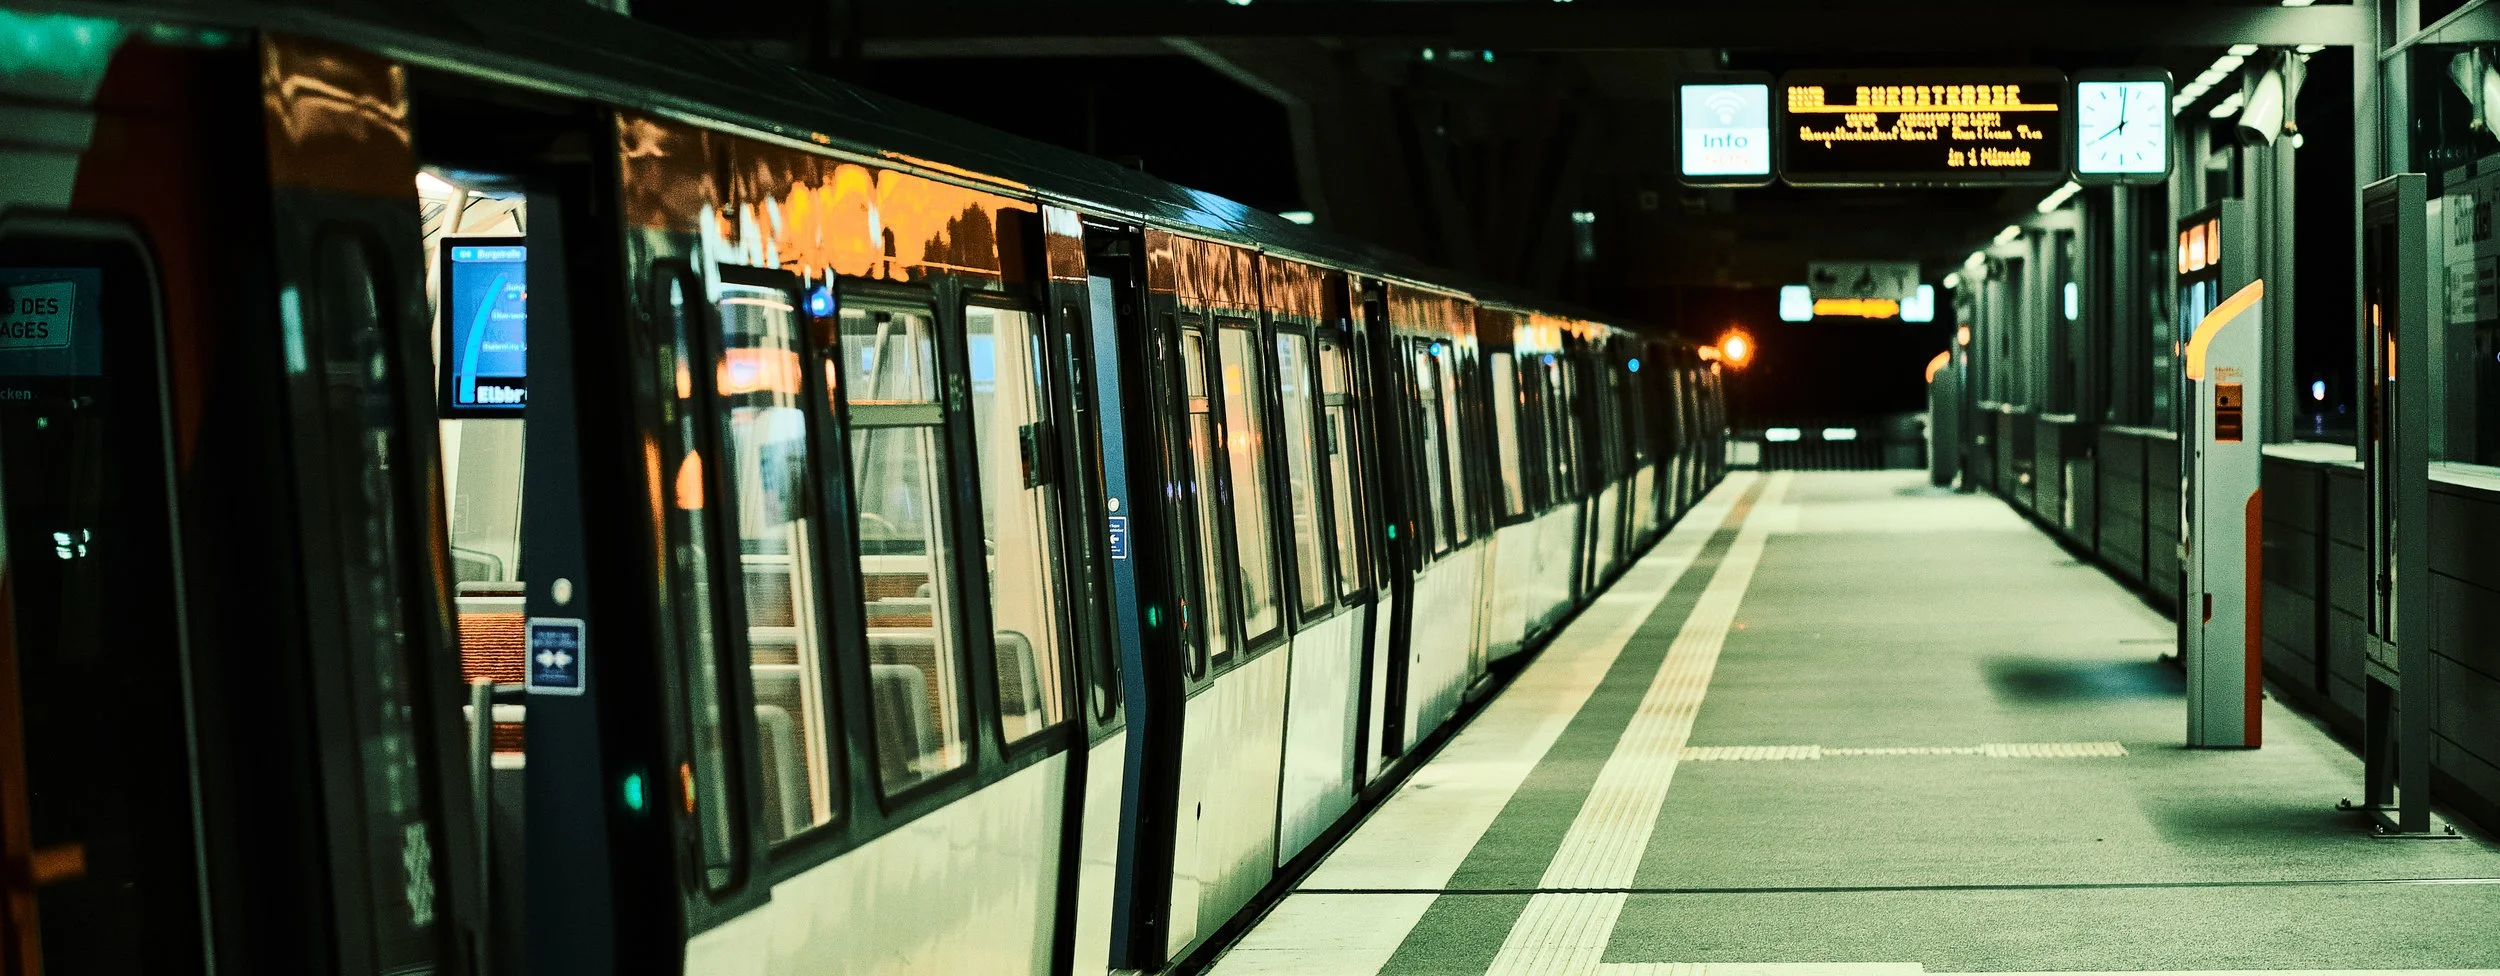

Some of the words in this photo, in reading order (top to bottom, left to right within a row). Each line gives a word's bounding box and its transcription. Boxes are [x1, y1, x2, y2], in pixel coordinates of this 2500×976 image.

[1703, 132, 1748, 149] Info
[1947, 147, 1964, 167] in
[1980, 146, 2031, 167] Minute
[21, 297, 59, 315] DES
[0, 321, 49, 339] AGES
[0, 387, 32, 400] cken
[477, 386, 528, 404] Elbbr
